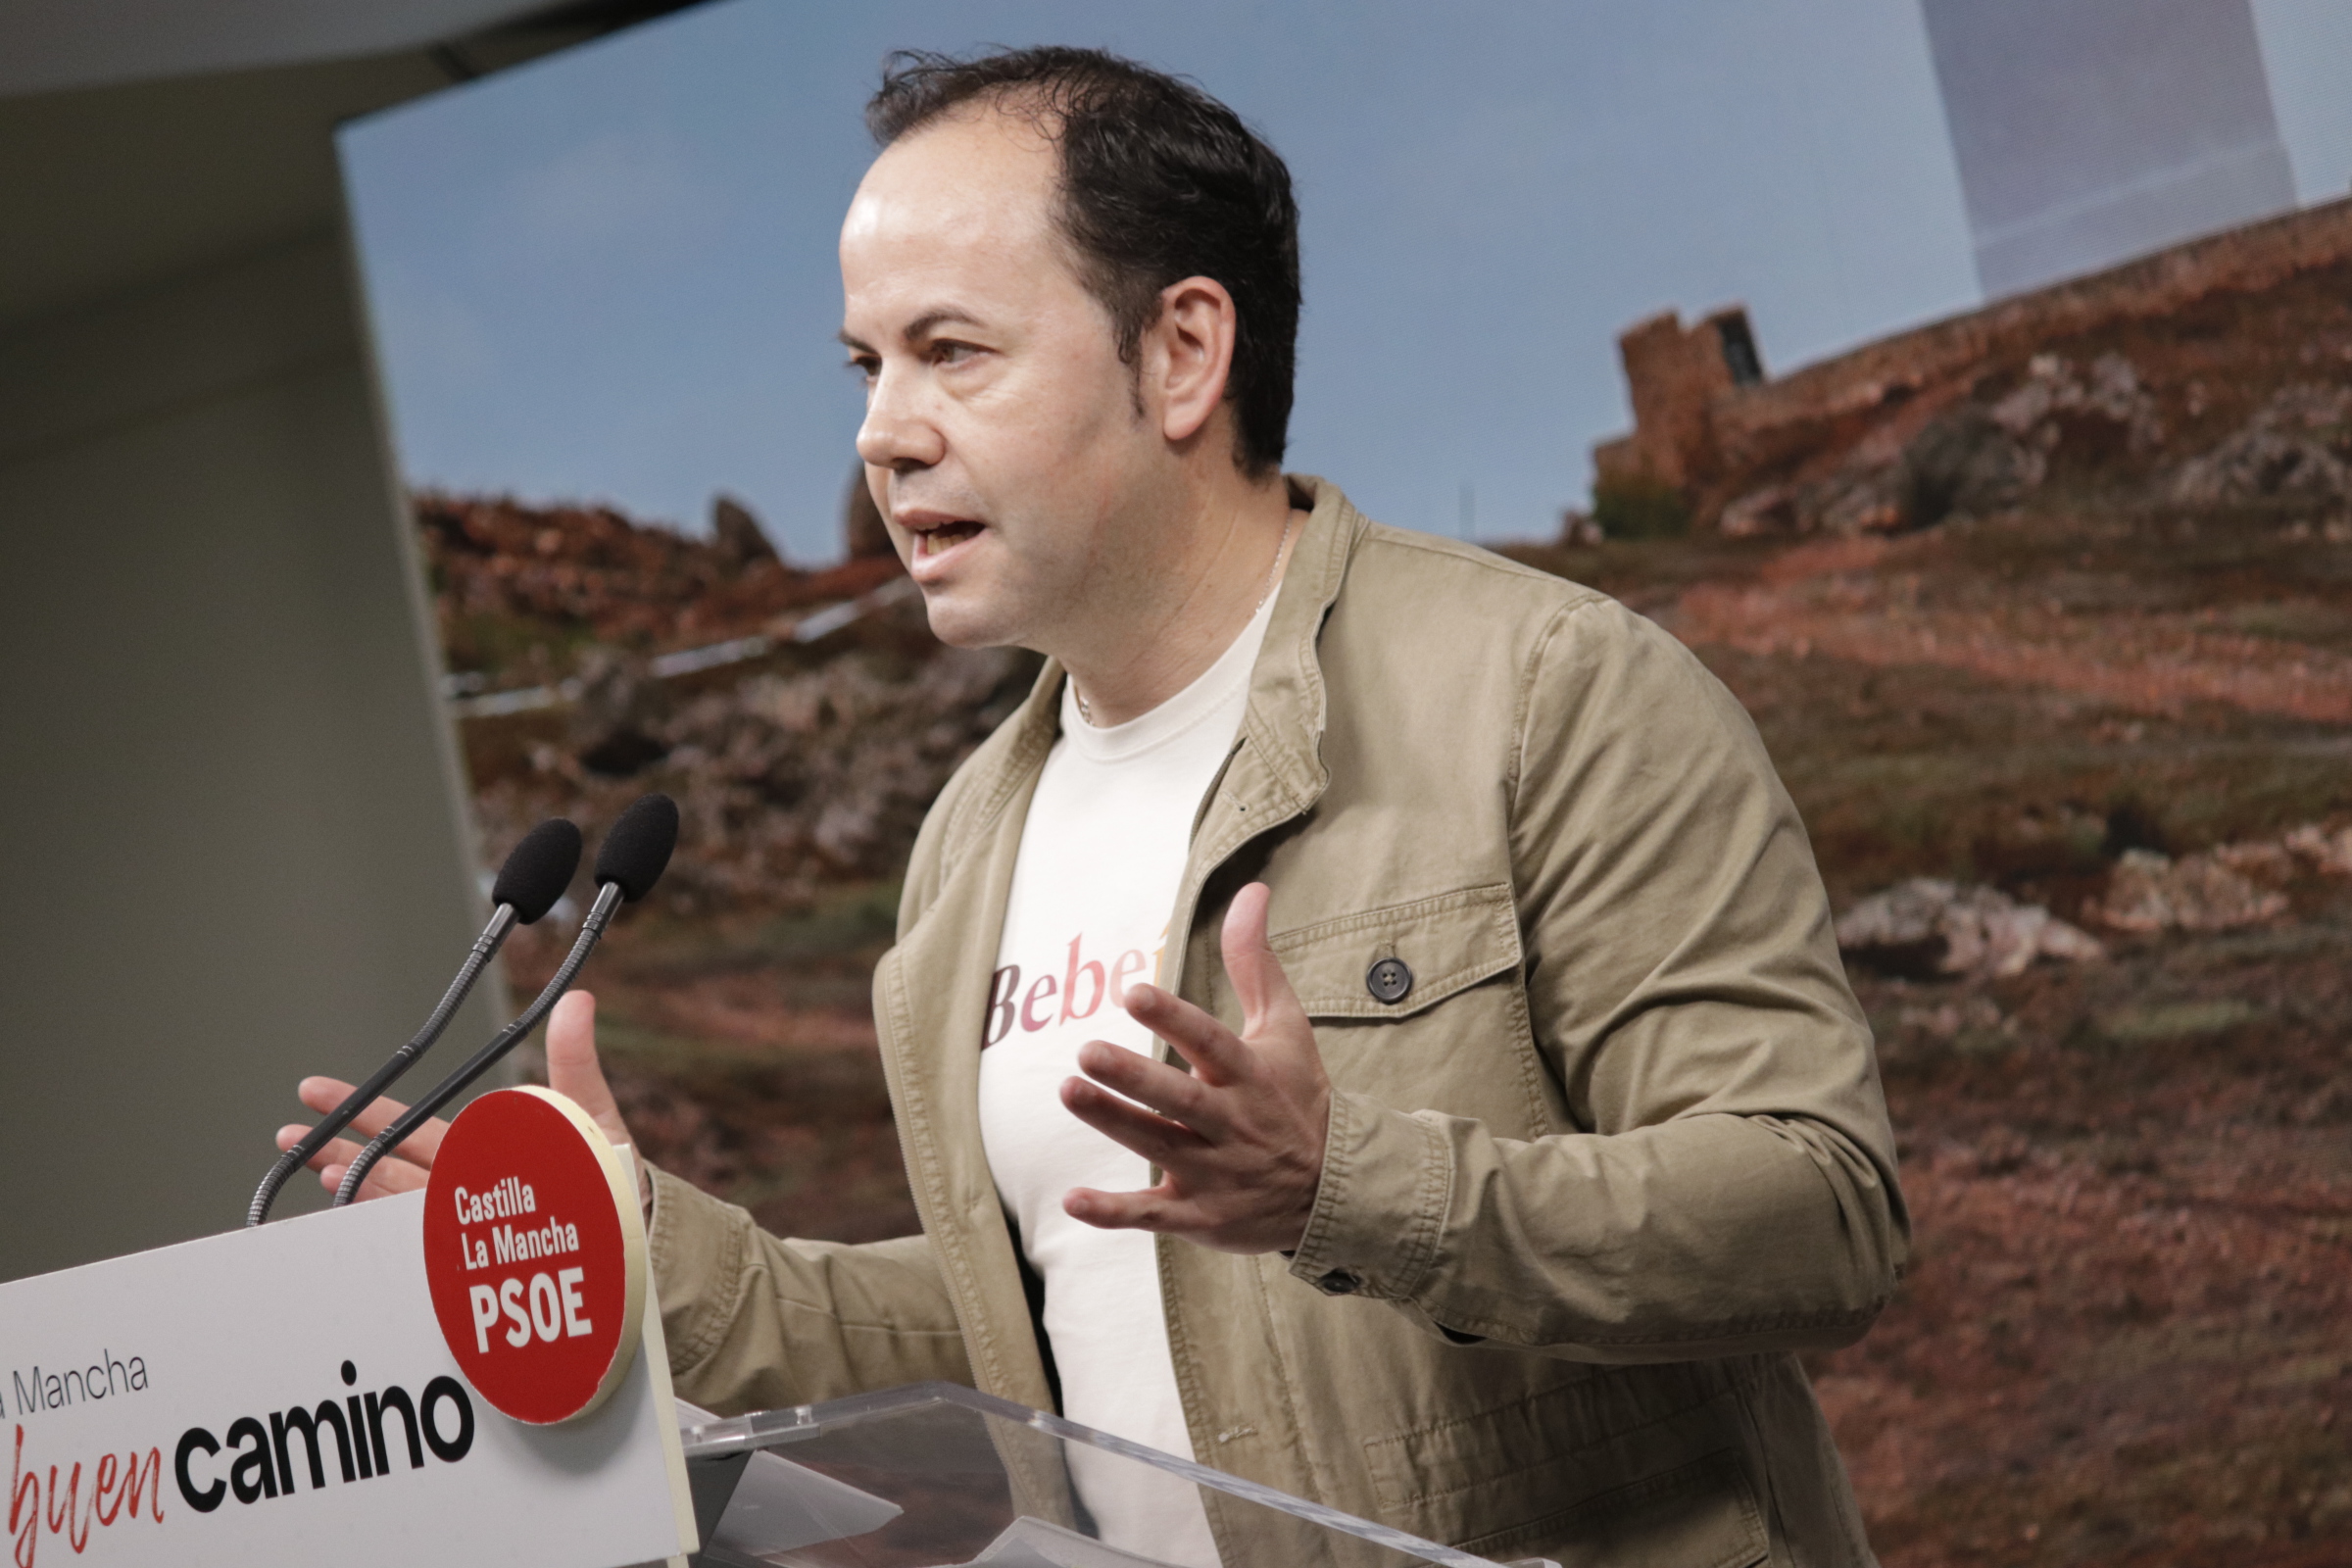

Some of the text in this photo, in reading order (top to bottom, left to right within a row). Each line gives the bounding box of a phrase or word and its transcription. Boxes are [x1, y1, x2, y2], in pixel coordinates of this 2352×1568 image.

[454, 1176, 537, 1225] Castilla
[461, 1215, 580, 1271] La Mancha
[468, 1266, 593, 1354] PSOE
[13, 1348, 149, 1415] Mancha
[9, 1359, 475, 1568] buen camino
